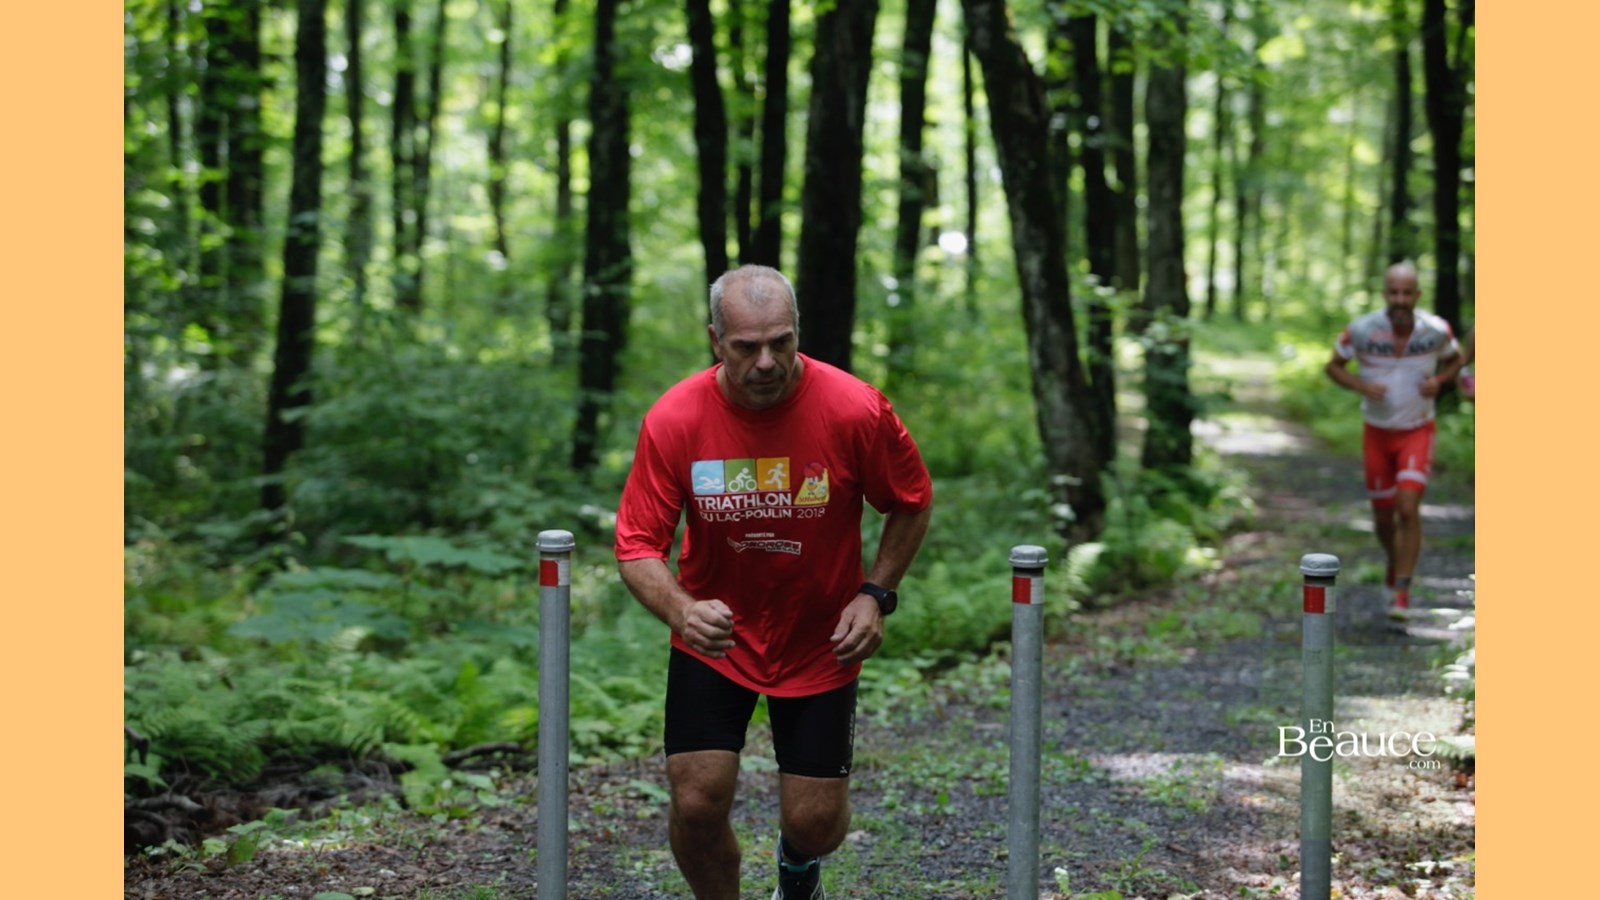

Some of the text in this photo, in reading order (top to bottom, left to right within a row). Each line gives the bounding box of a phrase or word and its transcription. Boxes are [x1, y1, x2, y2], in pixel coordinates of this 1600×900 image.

[694, 493, 792, 511] TRIATHLON
[716, 508, 792, 522] LAC-POULIN
[796, 507, 826, 519] 2018
